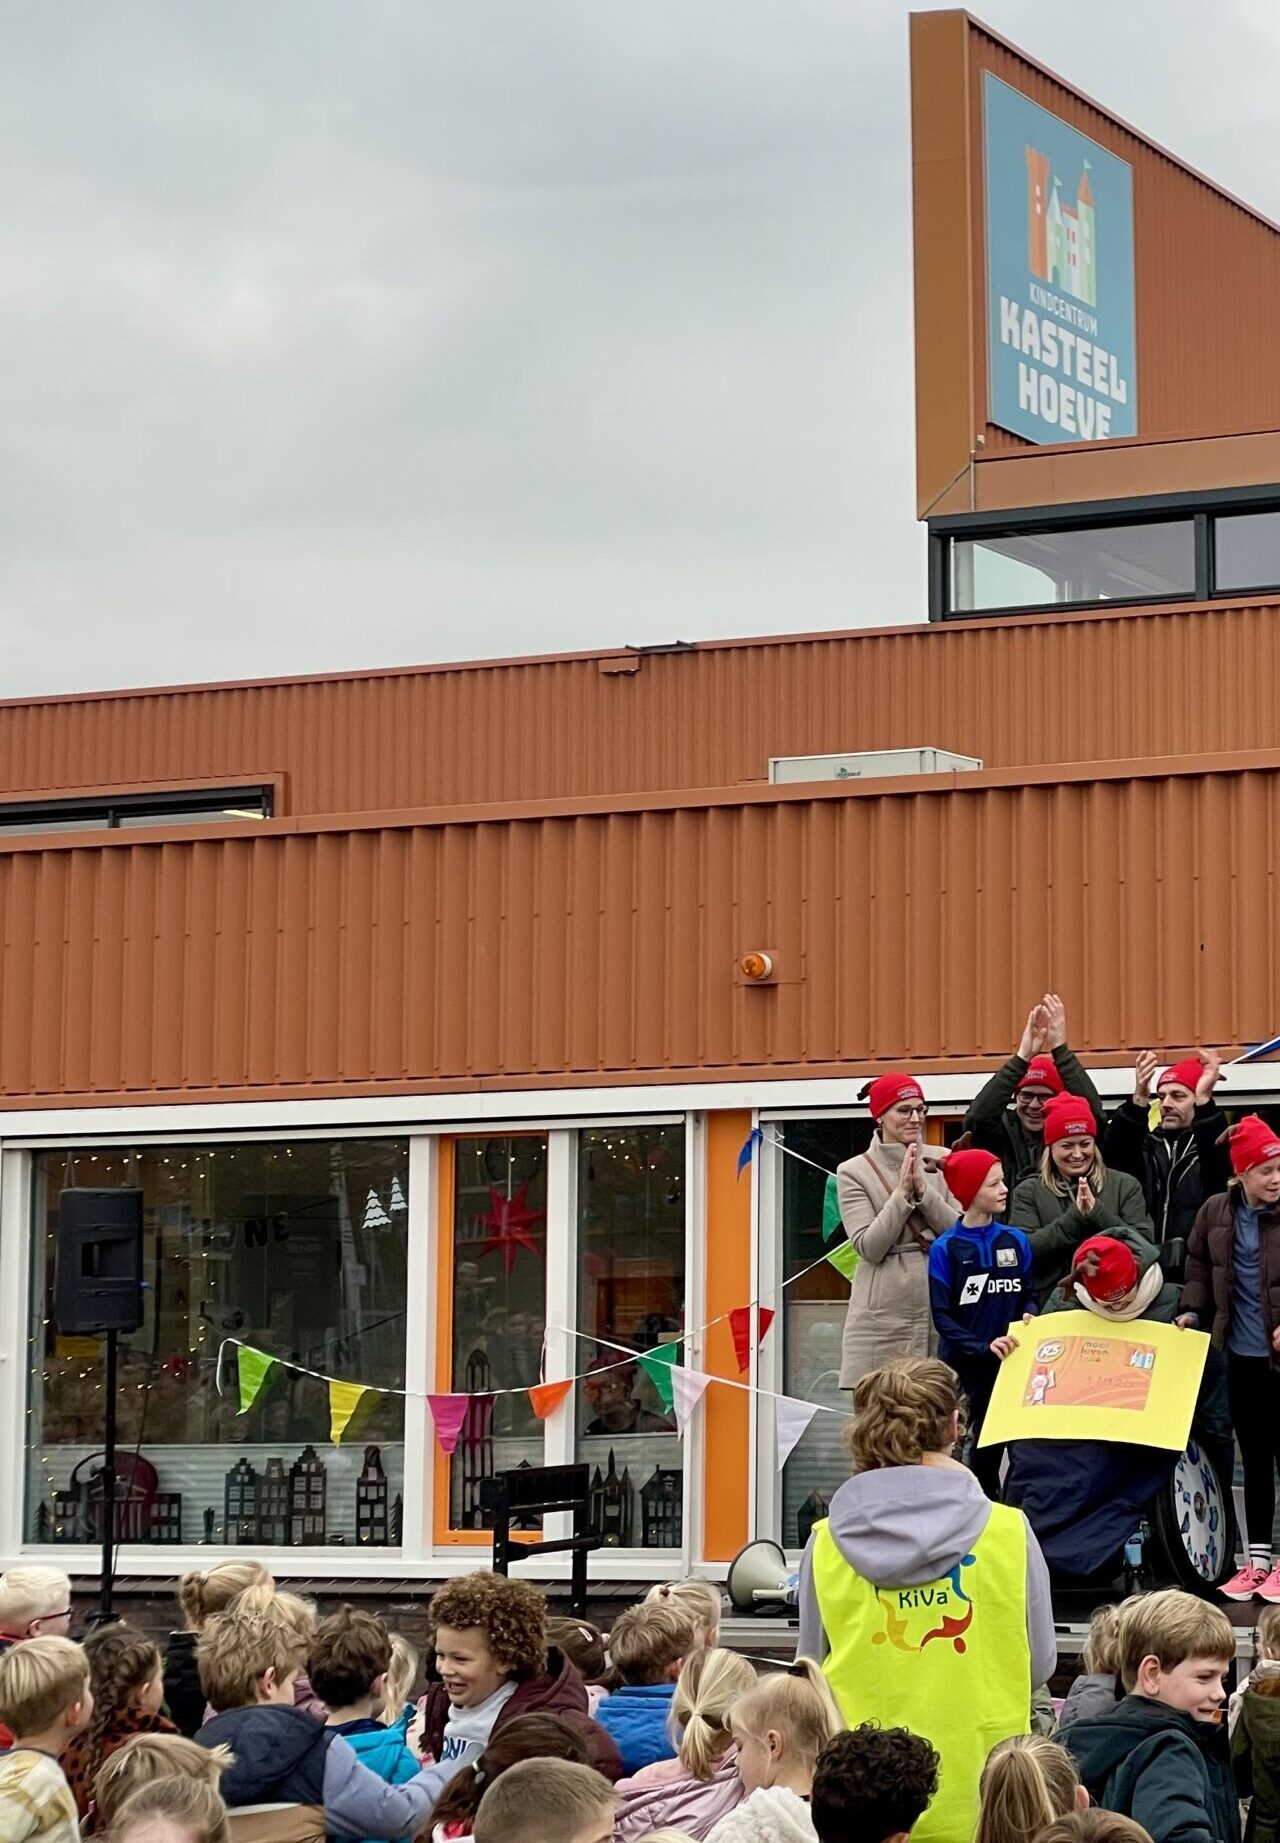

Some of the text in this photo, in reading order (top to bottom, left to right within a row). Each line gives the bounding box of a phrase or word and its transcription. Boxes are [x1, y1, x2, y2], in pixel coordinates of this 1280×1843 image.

[1030, 283, 1098, 336] KINDCENTRUM
[1001, 295, 1127, 405] KASTEEL
[1019, 362, 1112, 440] HOEVE
[987, 1278, 1022, 1294] DFDS
[899, 1588, 949, 1609] KiVa
